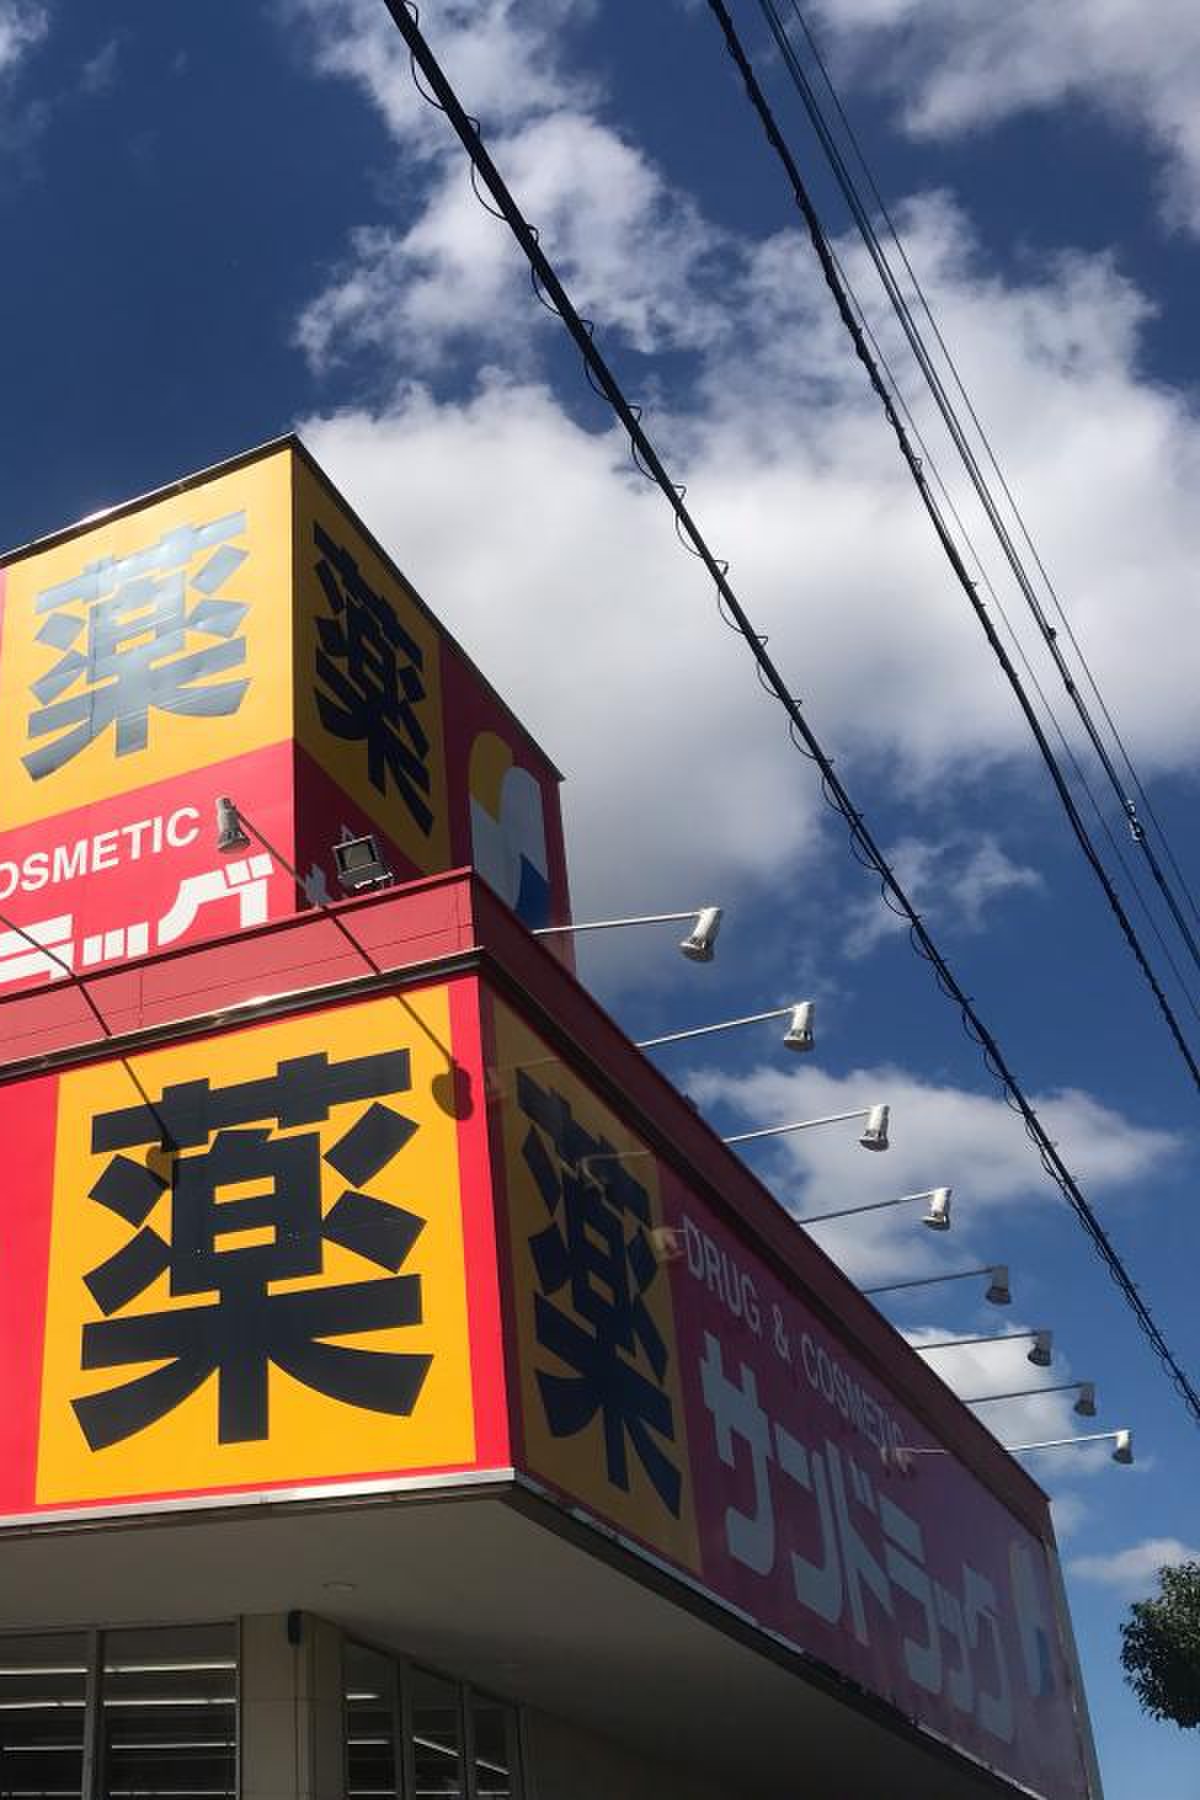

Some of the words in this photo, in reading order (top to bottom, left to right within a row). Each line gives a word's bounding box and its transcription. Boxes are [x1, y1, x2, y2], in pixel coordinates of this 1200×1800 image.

[21, 511, 250, 781] 薬
[313, 520, 434, 838] 薬
[70, 1048, 434, 1452] 薬
[516, 1067, 682, 1520] 薬
[683, 1214, 761, 1336] DRUG
